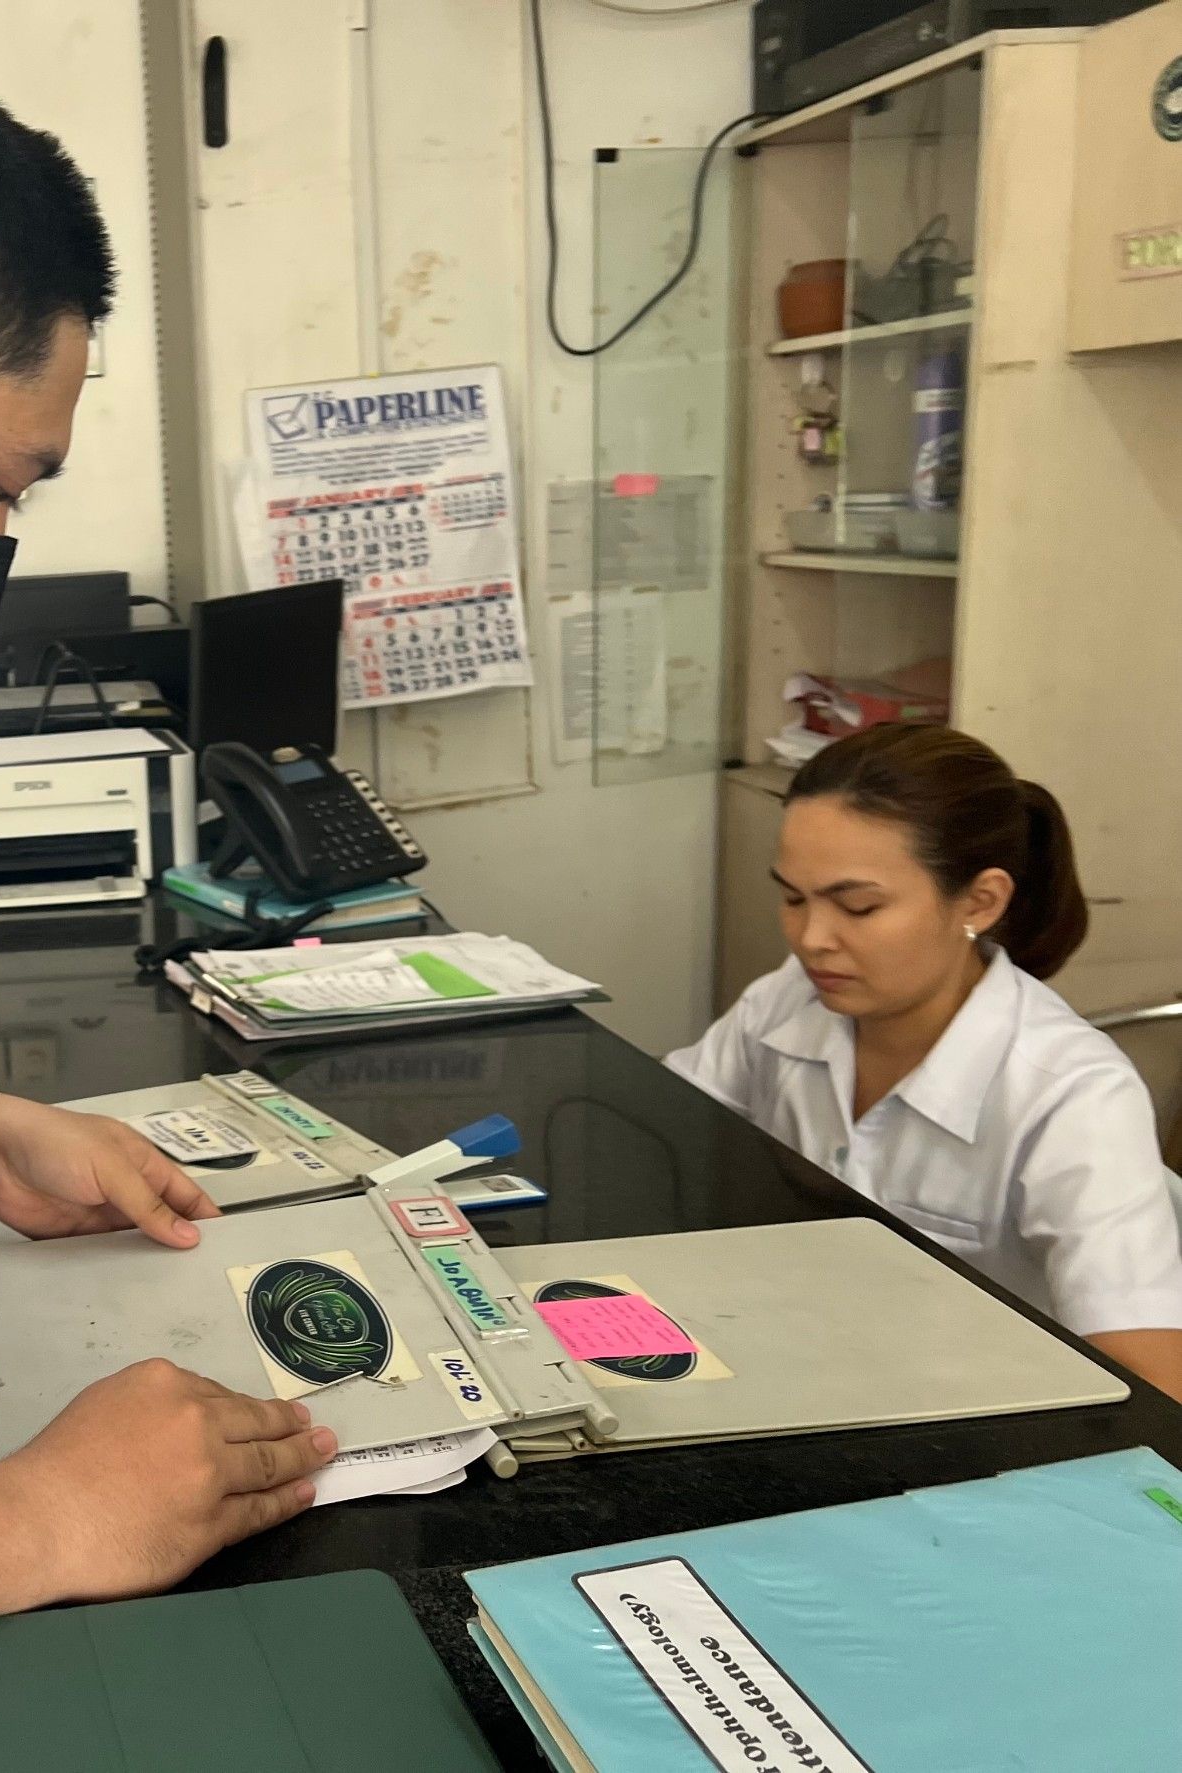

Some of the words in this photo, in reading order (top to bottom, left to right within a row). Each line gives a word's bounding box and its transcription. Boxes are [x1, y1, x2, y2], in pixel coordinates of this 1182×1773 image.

[314, 384, 484, 428] PAPERLINE
[14, 781, 51, 791] EPSON
[619, 1593, 767, 1762] Ophthalmology)
